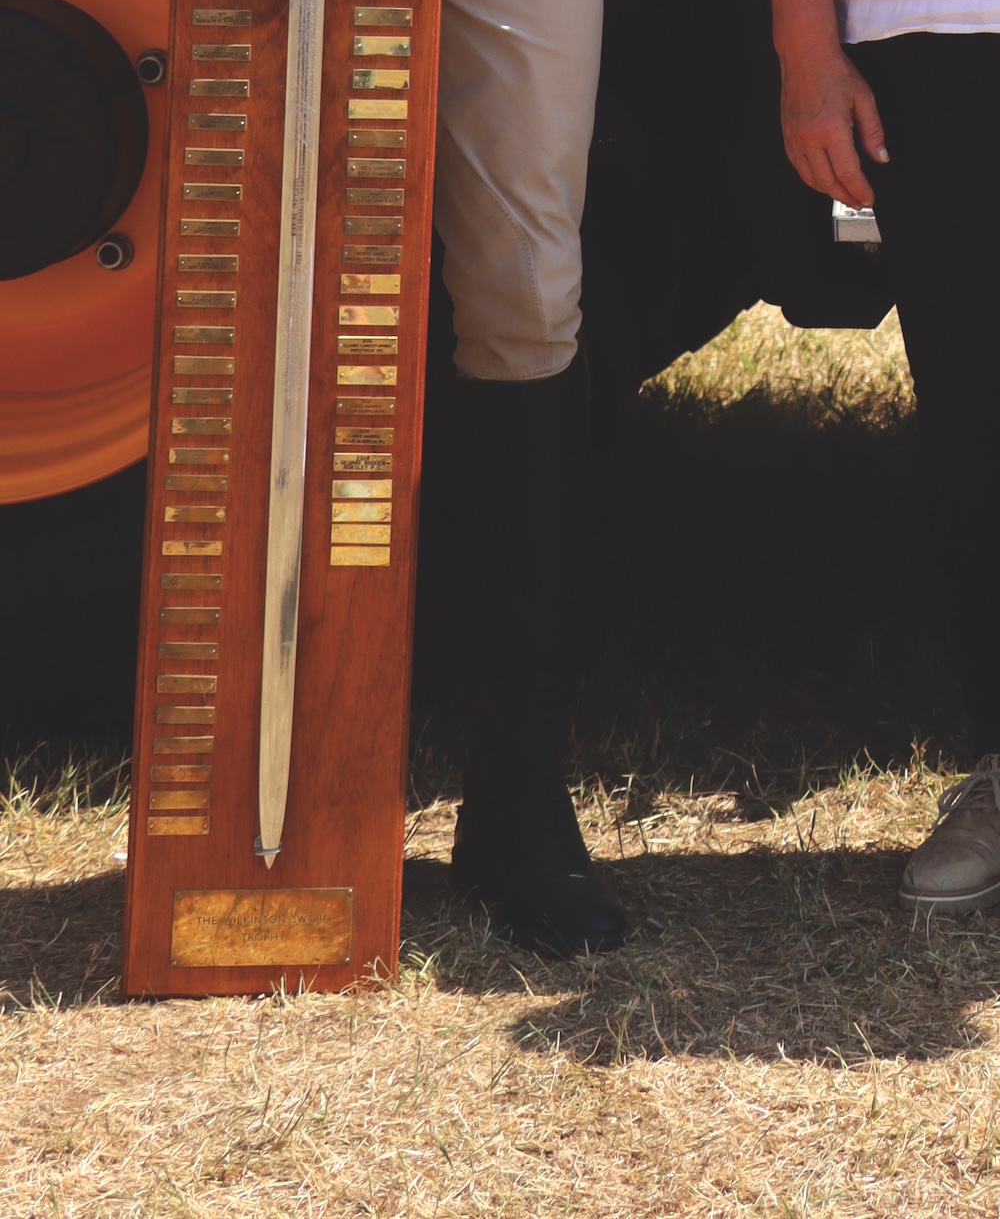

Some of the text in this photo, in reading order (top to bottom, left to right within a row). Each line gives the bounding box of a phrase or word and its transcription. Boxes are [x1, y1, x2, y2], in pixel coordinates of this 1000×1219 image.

[196, 916, 218, 925] THE
[223, 915, 286, 925] WILKINSON
[241, 933, 286, 942] TROPHY
